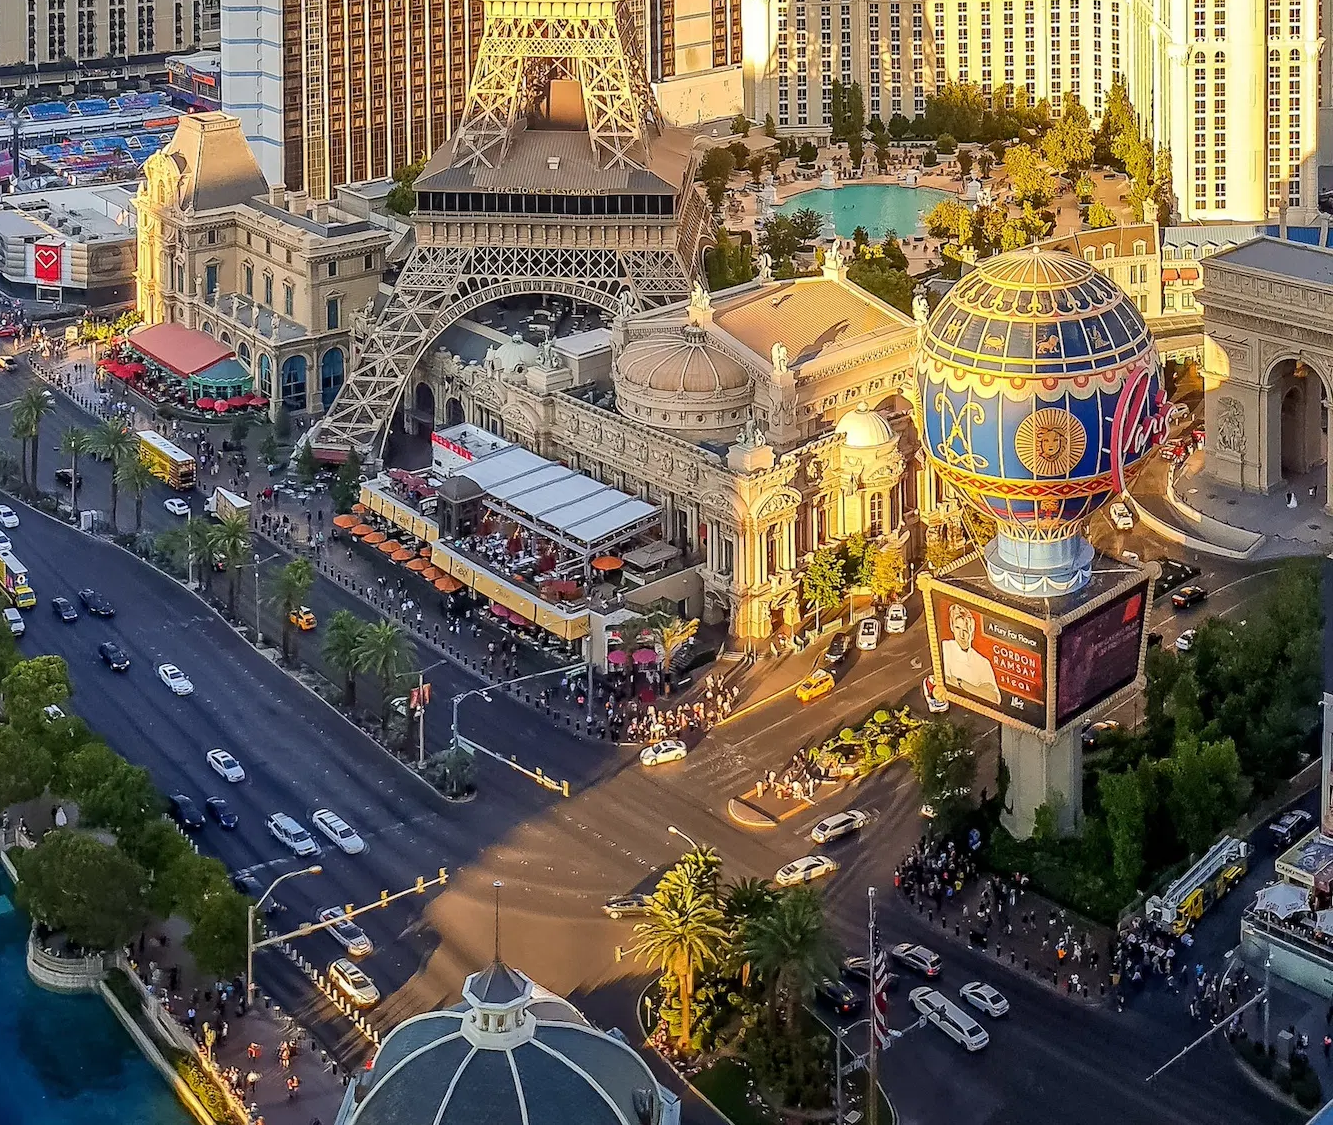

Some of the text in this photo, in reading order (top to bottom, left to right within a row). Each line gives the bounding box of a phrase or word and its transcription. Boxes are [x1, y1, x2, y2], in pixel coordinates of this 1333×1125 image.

[488, 186, 601, 195] EIFFEL TOWER RESTAURANT
[988, 623, 1037, 646] A Fury For Flavor
[993, 645, 1036, 668] GORDON
[993, 656, 1036, 679] RAMSAY
[1000, 675, 1031, 692] steak
